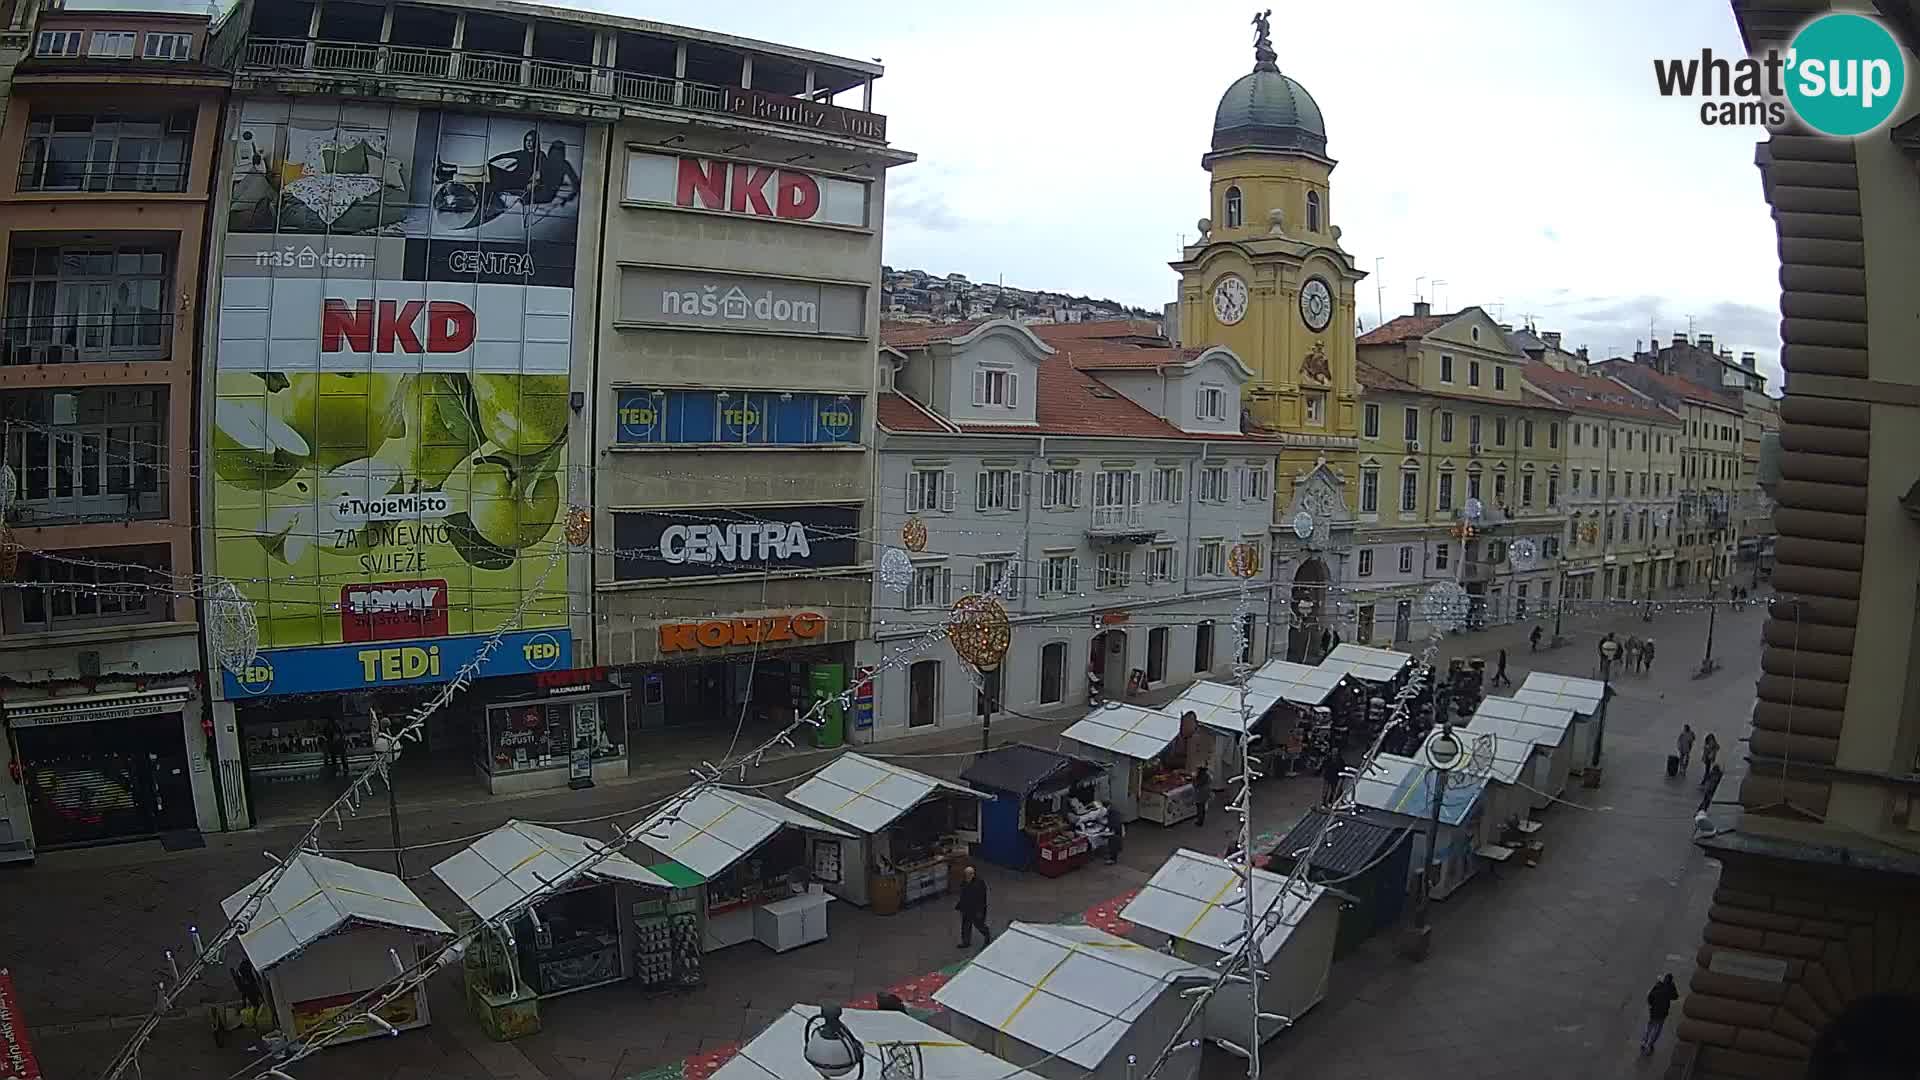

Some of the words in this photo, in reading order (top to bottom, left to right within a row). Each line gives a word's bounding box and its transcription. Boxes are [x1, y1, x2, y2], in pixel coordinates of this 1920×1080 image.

[723, 89, 745, 113] Le
[752, 95, 825, 127] Rendez
[676, 158, 821, 221] NKD
[255, 244, 296, 268] naš
[320, 246, 367, 270] dom
[448, 249, 536, 277] CENTRA
[662, 285, 718, 318] naš
[754, 291, 818, 326] dom
[321, 298, 477, 354] NKD
[619, 407, 658, 425] TEDi
[724, 409, 760, 426] TEDi
[338, 497, 447, 517] #TvojeMisto
[334, 528, 359, 549] ZA
[367, 523, 451, 548] DNEVNO
[659, 522, 811, 564] CENTRA
[359, 547, 428, 575] SVJEŽE
[349, 586, 440, 615] TOMMY
[658, 611, 825, 653] KORZO
[359, 647, 441, 682] TEDi
[523, 644, 561, 662] TEDi
